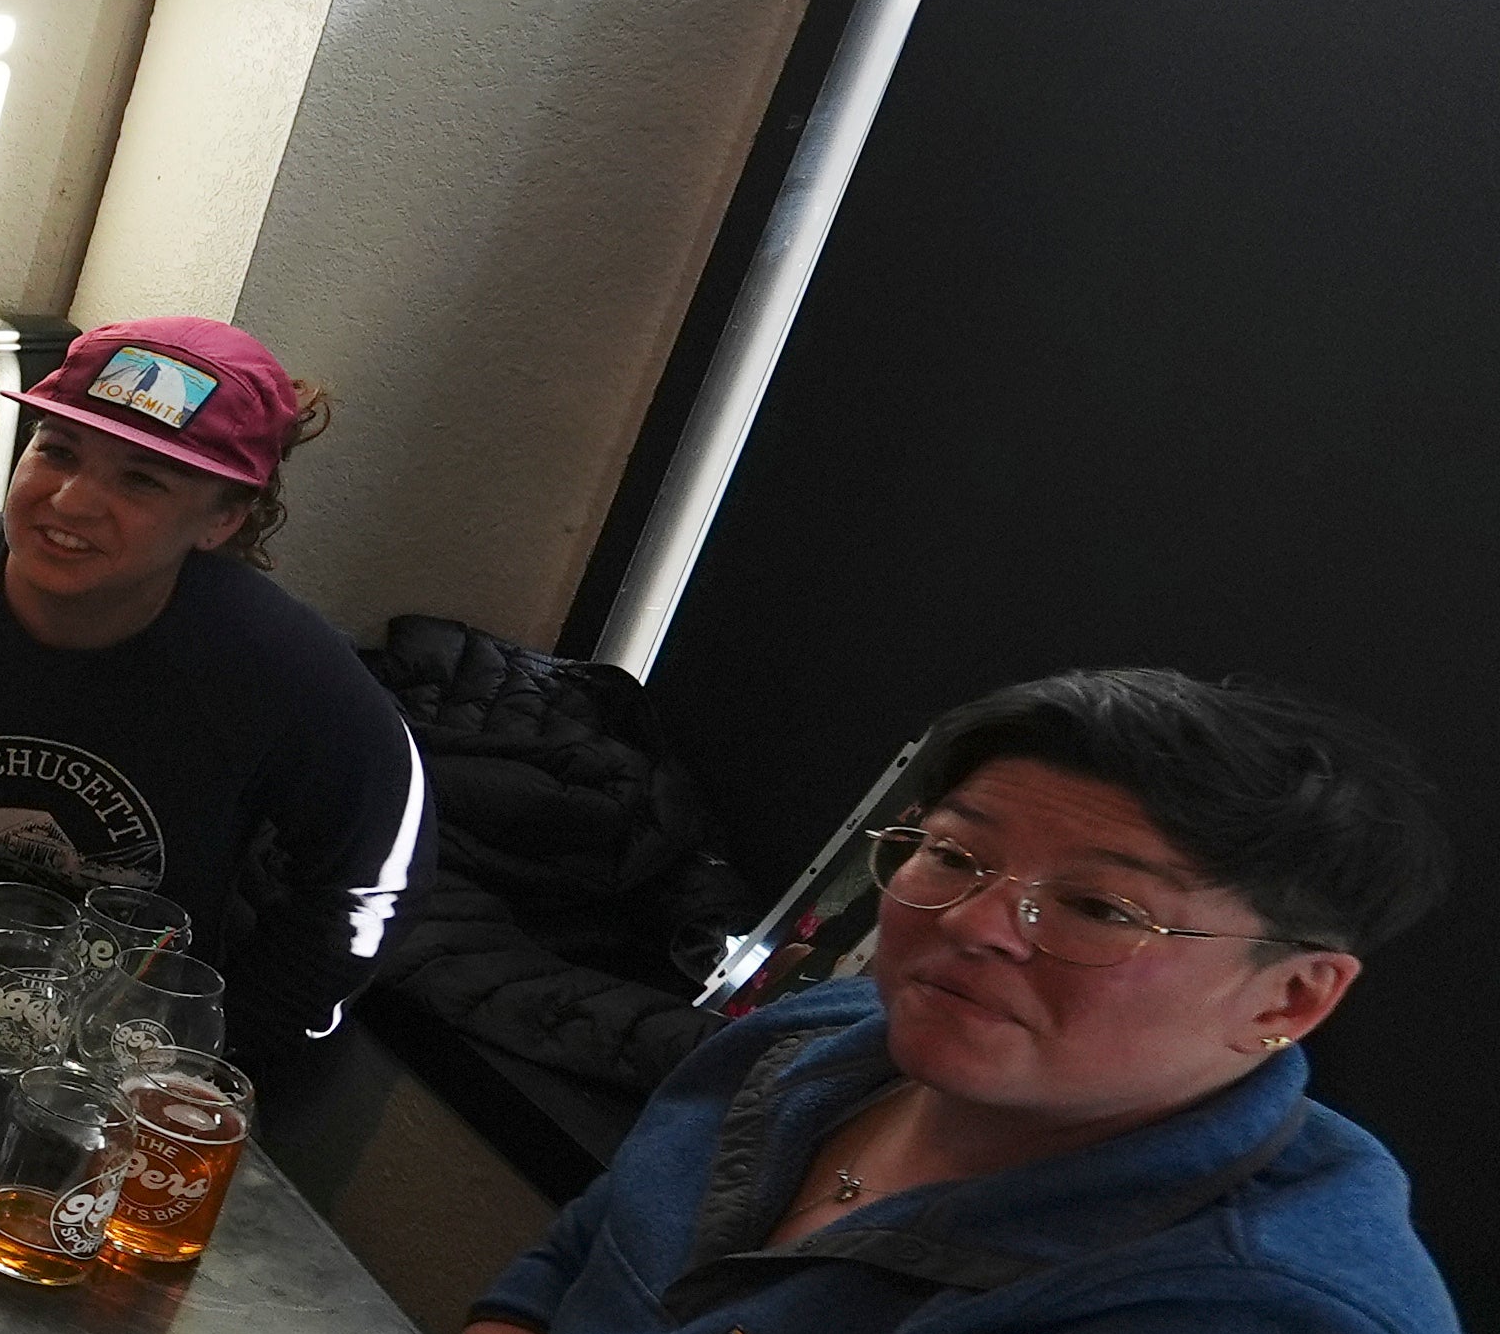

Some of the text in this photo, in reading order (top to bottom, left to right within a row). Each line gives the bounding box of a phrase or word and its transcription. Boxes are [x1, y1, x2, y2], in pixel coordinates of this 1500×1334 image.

[97, 380, 185, 426] YOSEMITE
[138, 1134, 180, 1159] THE
[153, 1201, 193, 1221] BAR
